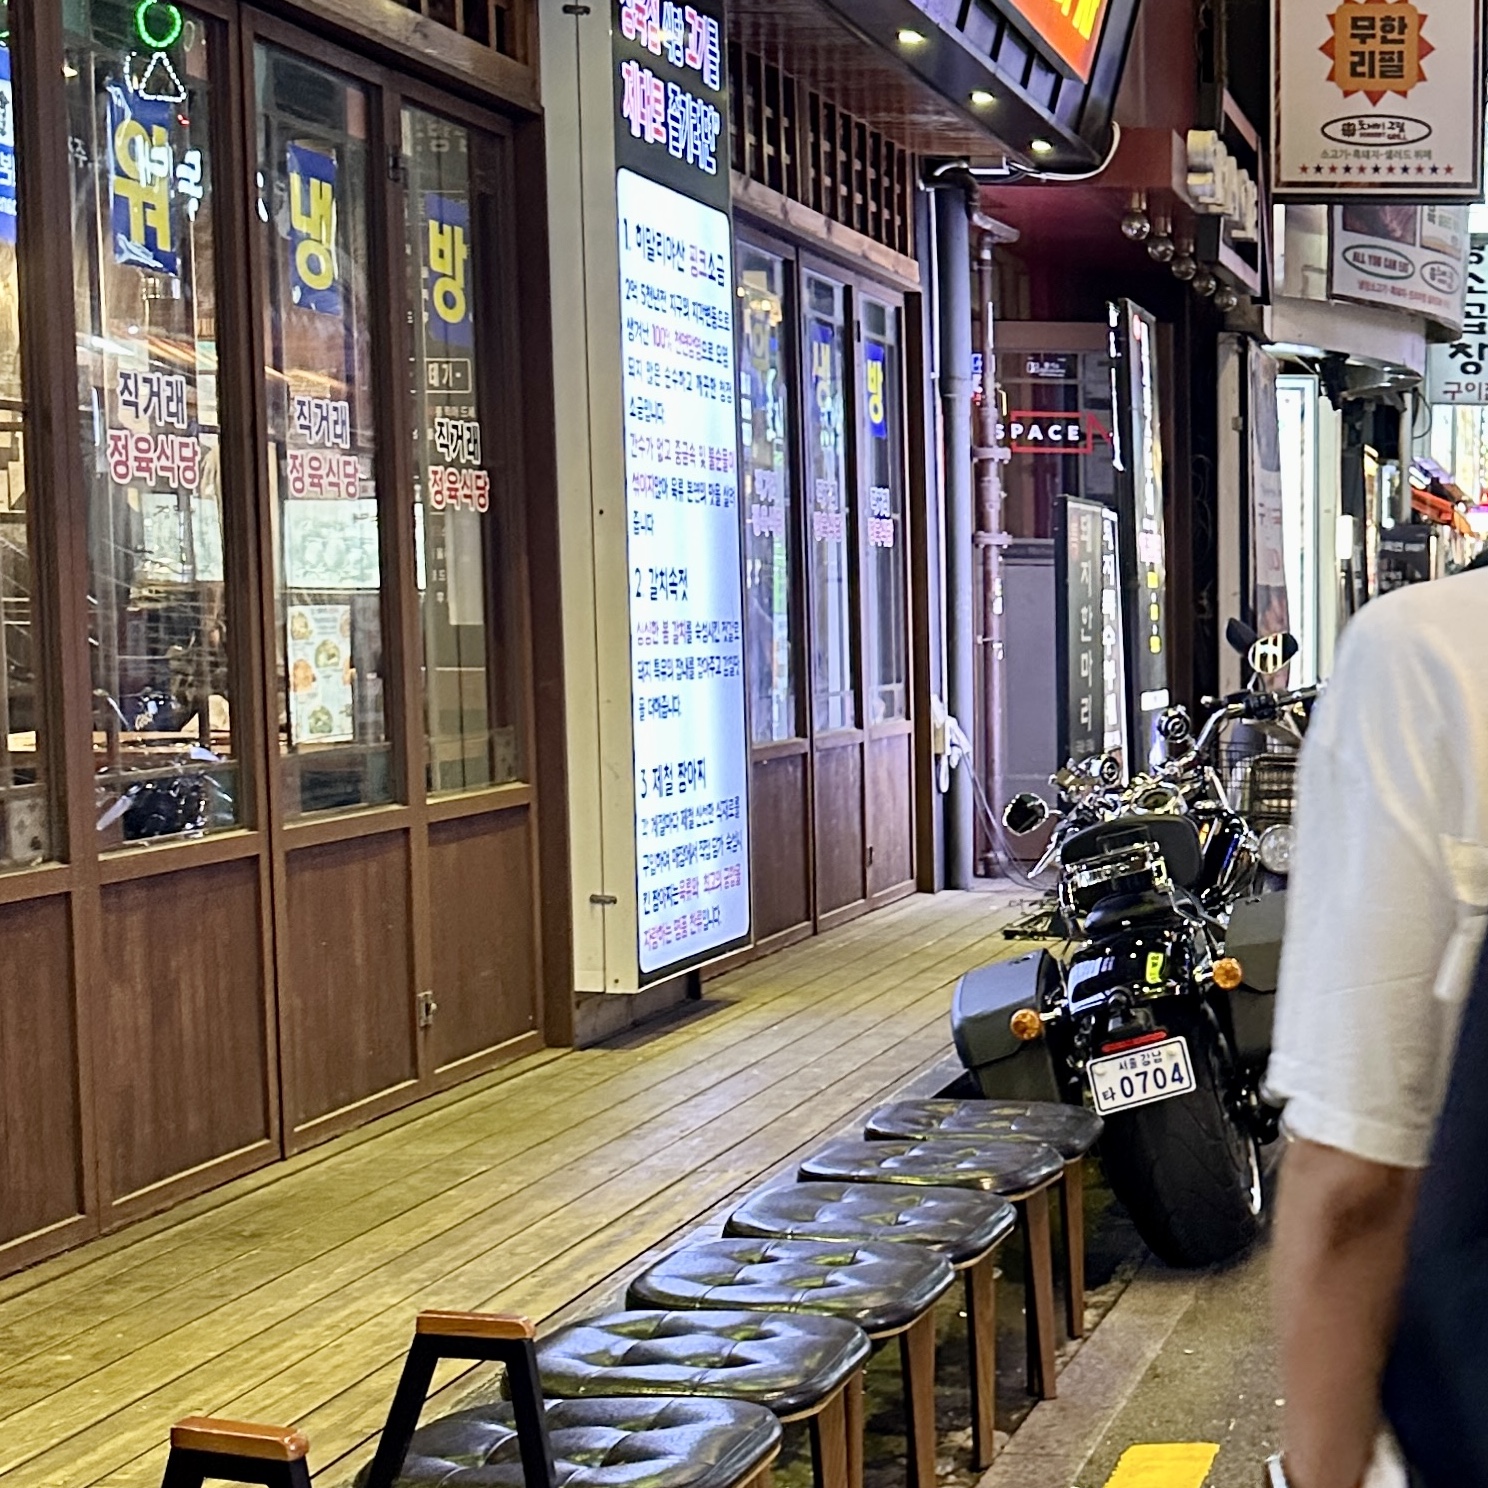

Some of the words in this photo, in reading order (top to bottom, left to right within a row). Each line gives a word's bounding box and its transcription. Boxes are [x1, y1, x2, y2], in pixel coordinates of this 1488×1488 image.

[1350, 15, 1408, 45] 무한
[1350, 50, 1405, 79] 리필
[622, 60, 666, 143] 제대로
[290, 171, 334, 290] 냉
[429, 219, 467, 324] 방
[117, 370, 187, 428] 직거래
[868, 358, 885, 424] 방
[295, 396, 350, 449] 직거래
[435, 418, 481, 465] 직거래
[995, 424, 1080, 441] SPACE
[108, 430, 199, 489] 정육식당
[288, 451, 359, 499] 정육식당
[429, 466, 489, 512] 정육식당
[648, 566, 687, 601] 갈치속젓
[653, 764, 673, 797] 제철
[1101, 1087, 1116, 1101] 타
[1120, 1062, 1184, 1098] 0704
[1118, 1057, 1137, 1070] 서울
[1141, 1050, 1163, 1067] 강남
